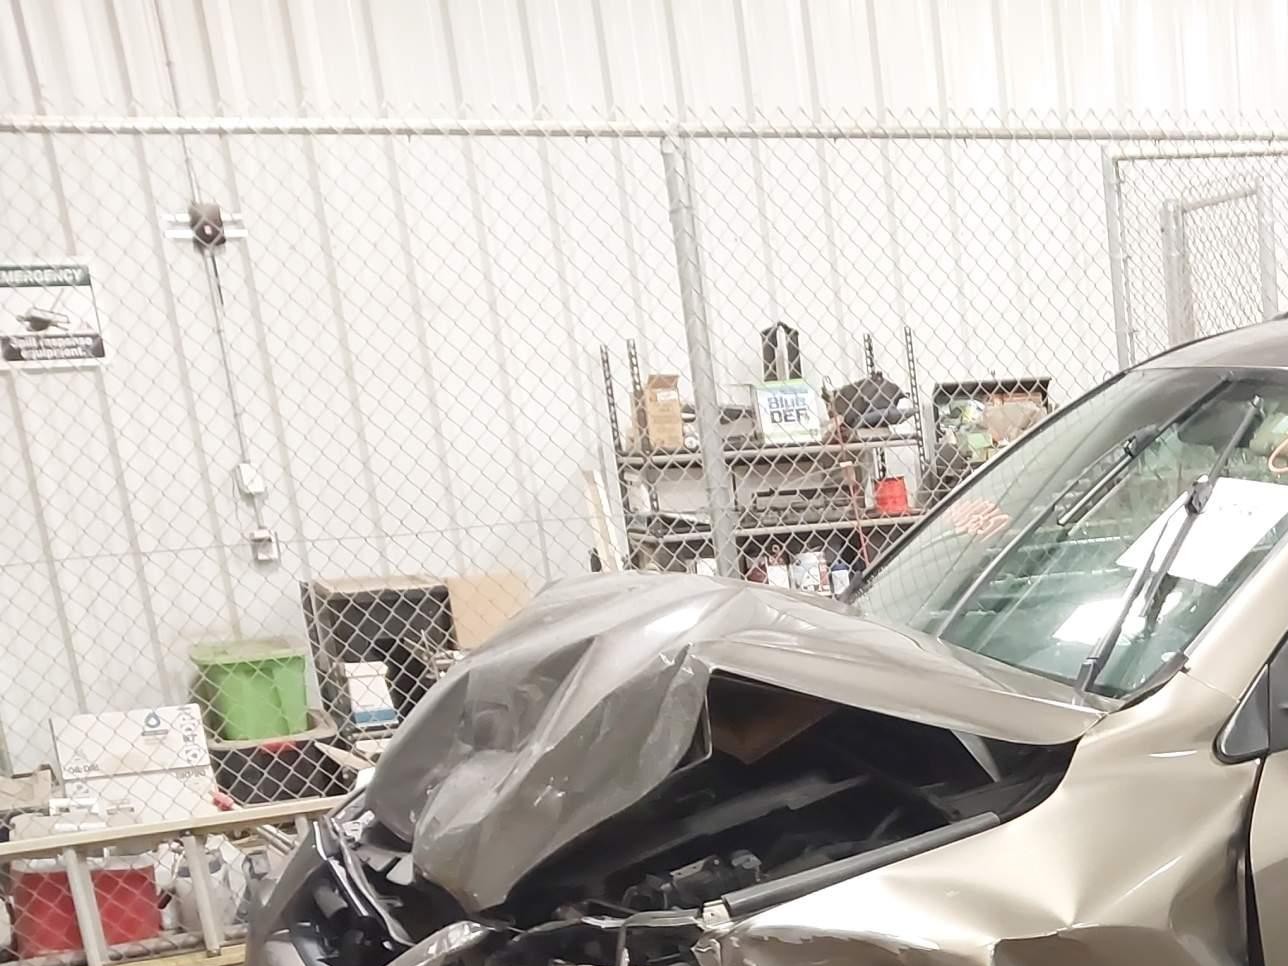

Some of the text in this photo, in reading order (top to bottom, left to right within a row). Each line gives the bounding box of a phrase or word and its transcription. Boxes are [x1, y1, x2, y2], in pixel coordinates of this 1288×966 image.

[0, 268, 82, 284] MERGENCY
[768, 396, 806, 409] Blue
[770, 408, 808, 423] DEF
